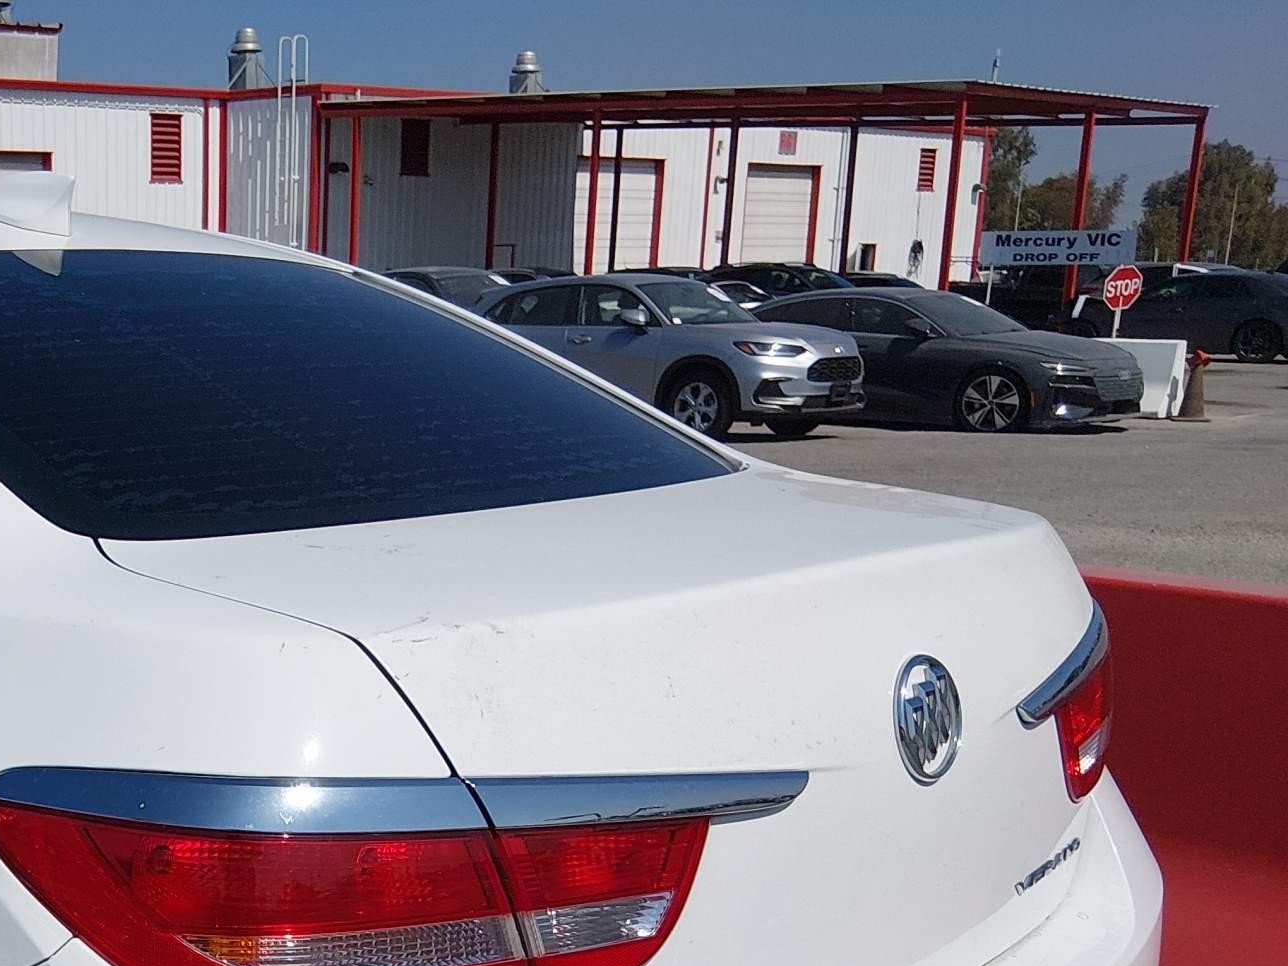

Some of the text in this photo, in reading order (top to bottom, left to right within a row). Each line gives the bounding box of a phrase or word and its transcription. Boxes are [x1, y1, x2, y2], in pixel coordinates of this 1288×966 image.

[995, 233, 1122, 249] Mercury VIC
[1012, 252, 1101, 262] DROP OFF
[1106, 278, 1140, 298] STOP
